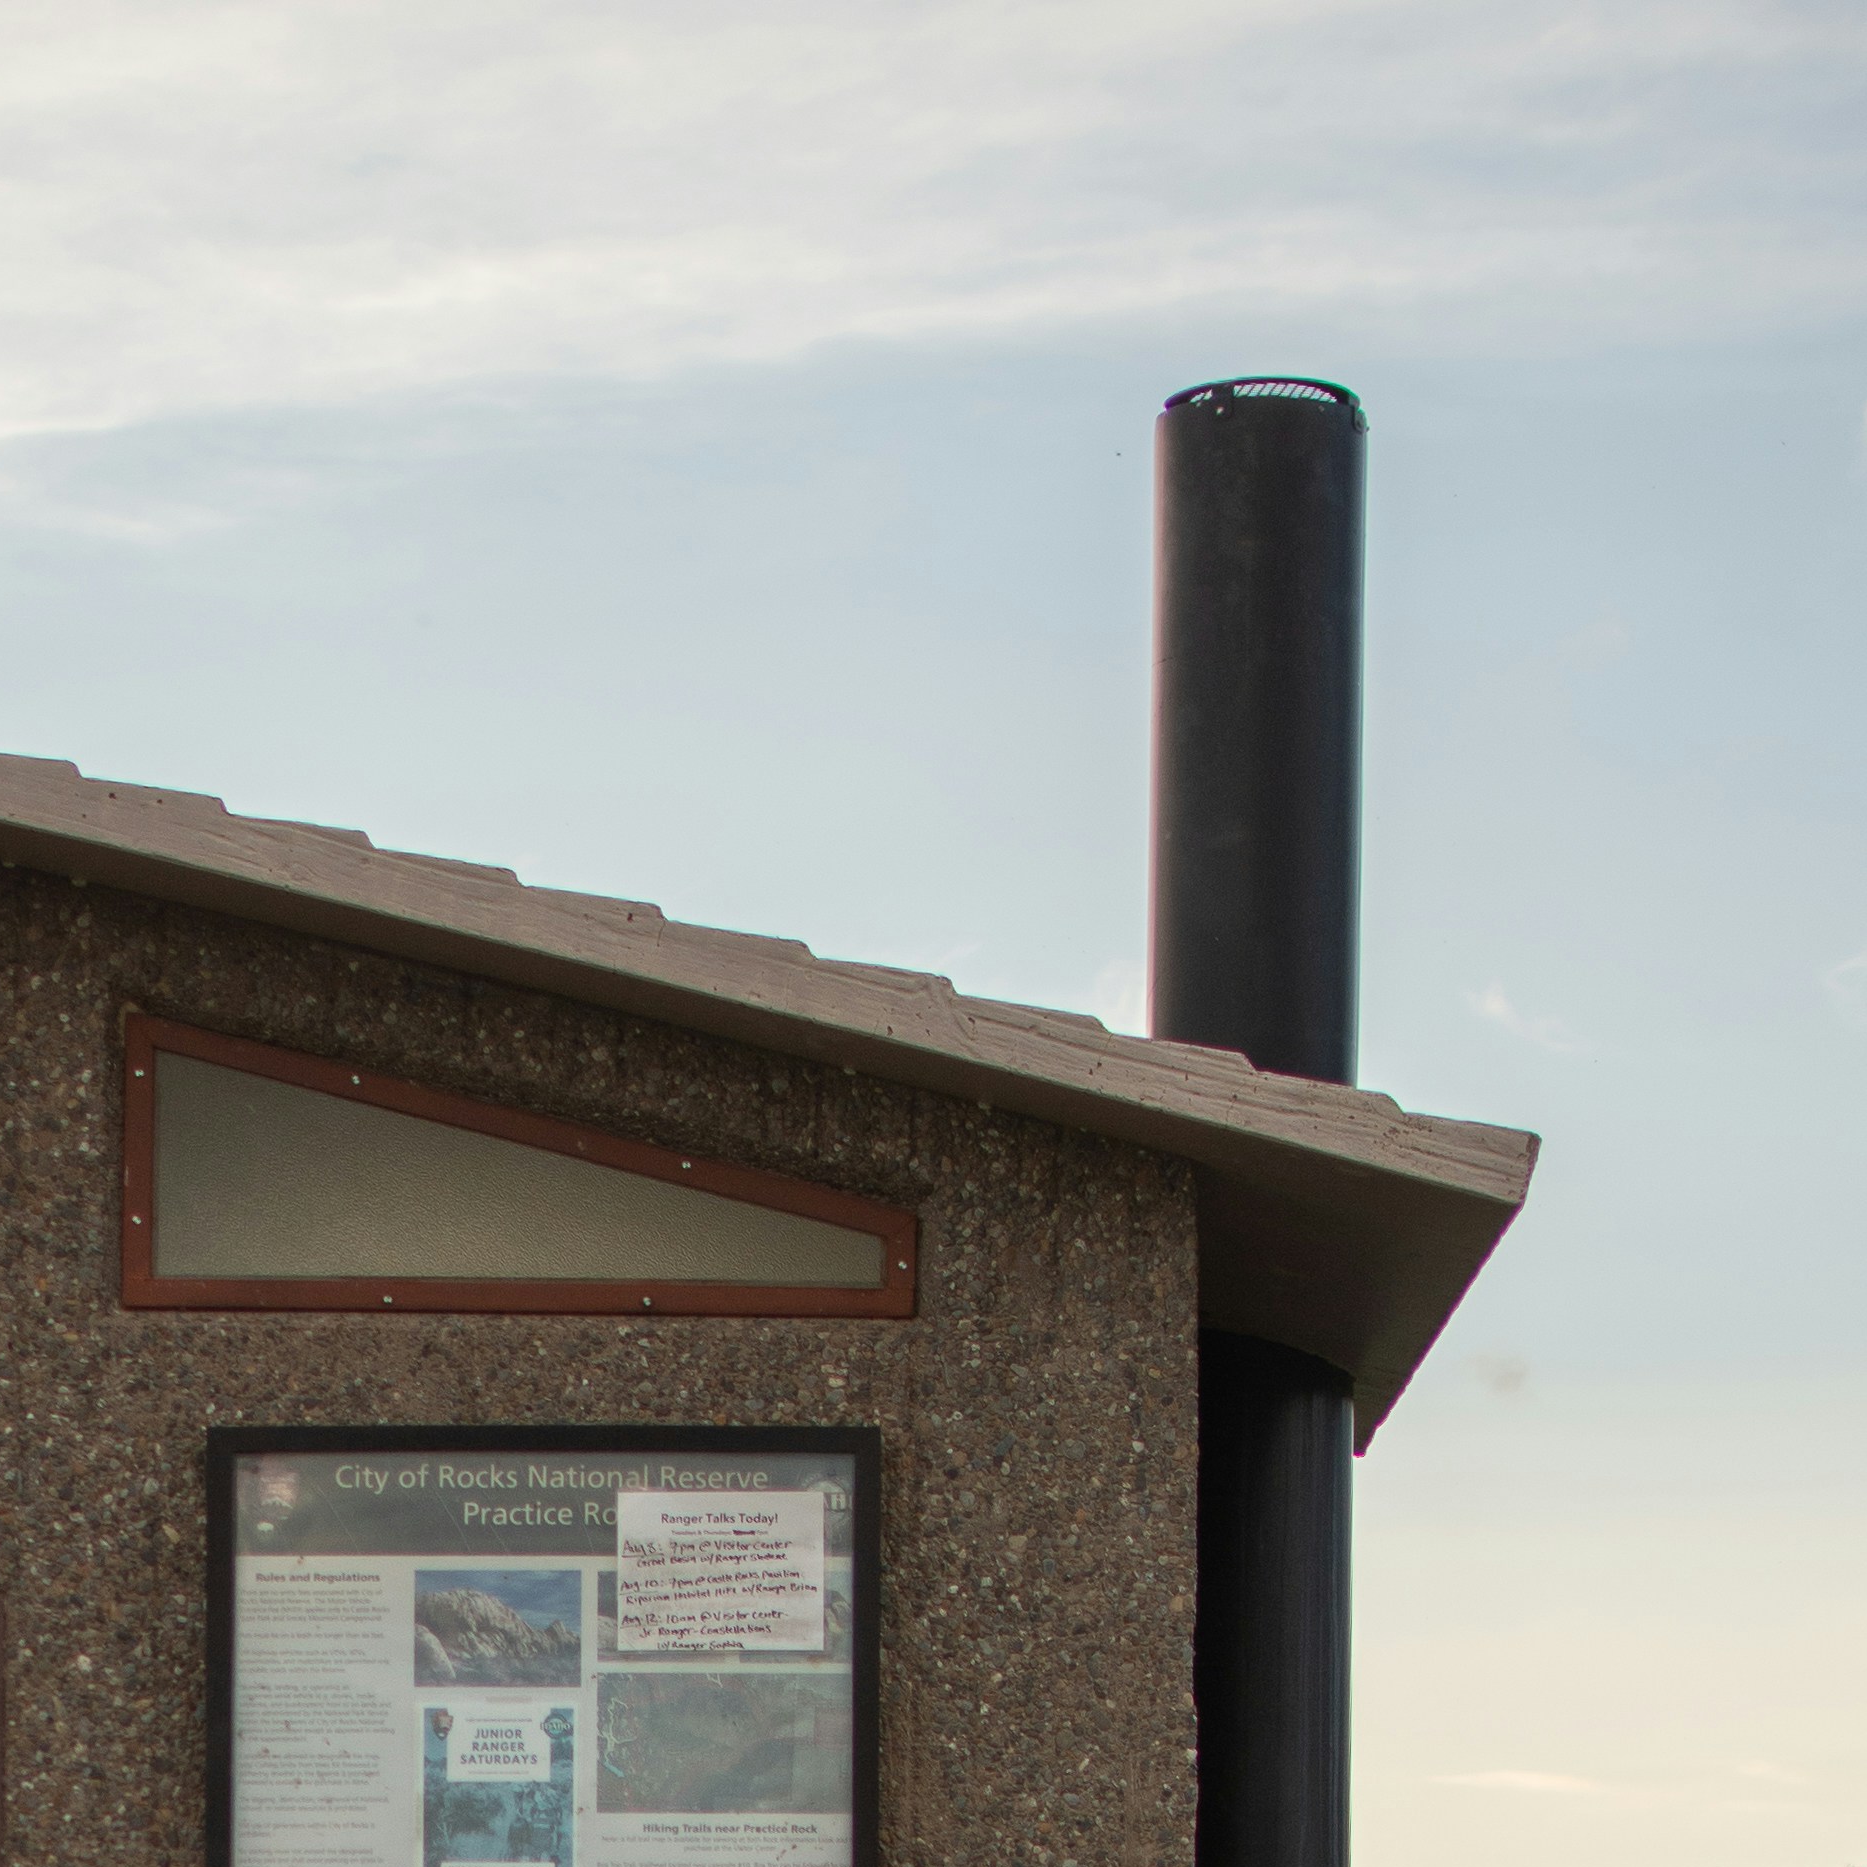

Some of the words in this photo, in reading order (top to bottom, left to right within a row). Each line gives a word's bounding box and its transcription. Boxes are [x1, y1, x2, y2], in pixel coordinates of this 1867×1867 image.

[335, 1465, 389, 1495] City
[398, 1464, 430, 1489] of
[438, 1464, 518, 1489] Rocks
[528, 1465, 648, 1489] National
[661, 1465, 769, 1489] Reserve
[463, 1501, 573, 1526] Practice
[661, 1513, 702, 1526] Ranger
[706, 1513, 736, 1524] Talks
[738, 1512, 778, 1526] Today!
[714, 1540, 750, 1551] Visitor
[255, 1572, 286, 1582] Rules
[289, 1572, 310, 1582] and
[313, 1572, 380, 1584] Regulations
[713, 1610, 750, 1621] Visitor
[474, 1729, 522, 1739] JUNIOR
[472, 1742, 525, 1752] RANGER
[460, 1754, 537, 1765] SATURDAYS
[642, 1824, 679, 1835] Hiking
[682, 1824, 712, 1834] Trails
[715, 1826, 740, 1834] near
[743, 1824, 788, 1834] Practice
[791, 1824, 818, 1834] Rock
